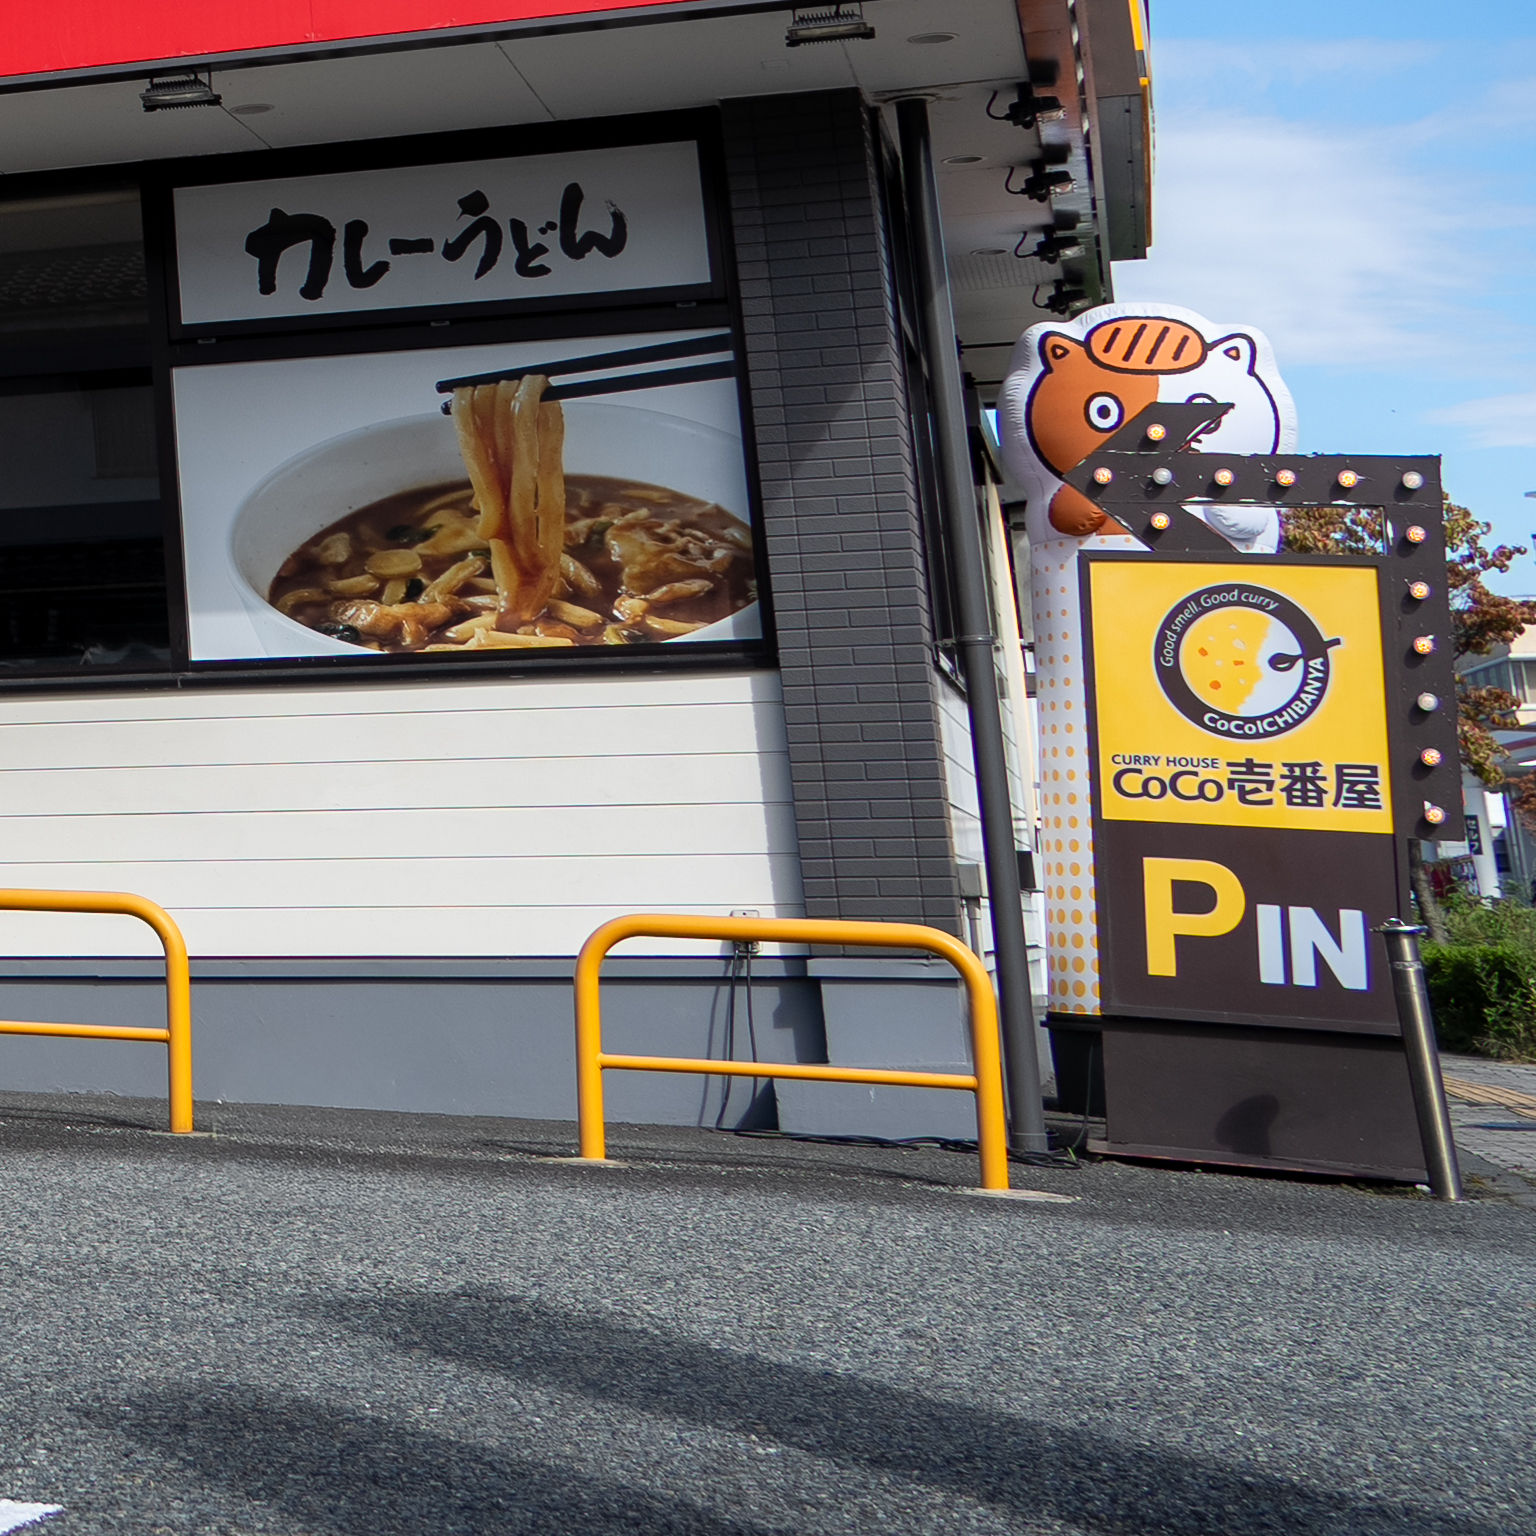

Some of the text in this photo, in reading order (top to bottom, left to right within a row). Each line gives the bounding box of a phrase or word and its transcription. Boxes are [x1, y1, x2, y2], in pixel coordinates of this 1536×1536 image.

[245, 182, 628, 300] カレーうどん
[1160, 589, 1279, 667] Good smell. Good curry
[1203, 657, 1325, 735] CoCoICHIBANYA
[1111, 754, 1220, 769] CURRY HOUSE
[1112, 758, 1383, 810] CoCo壱番屋
